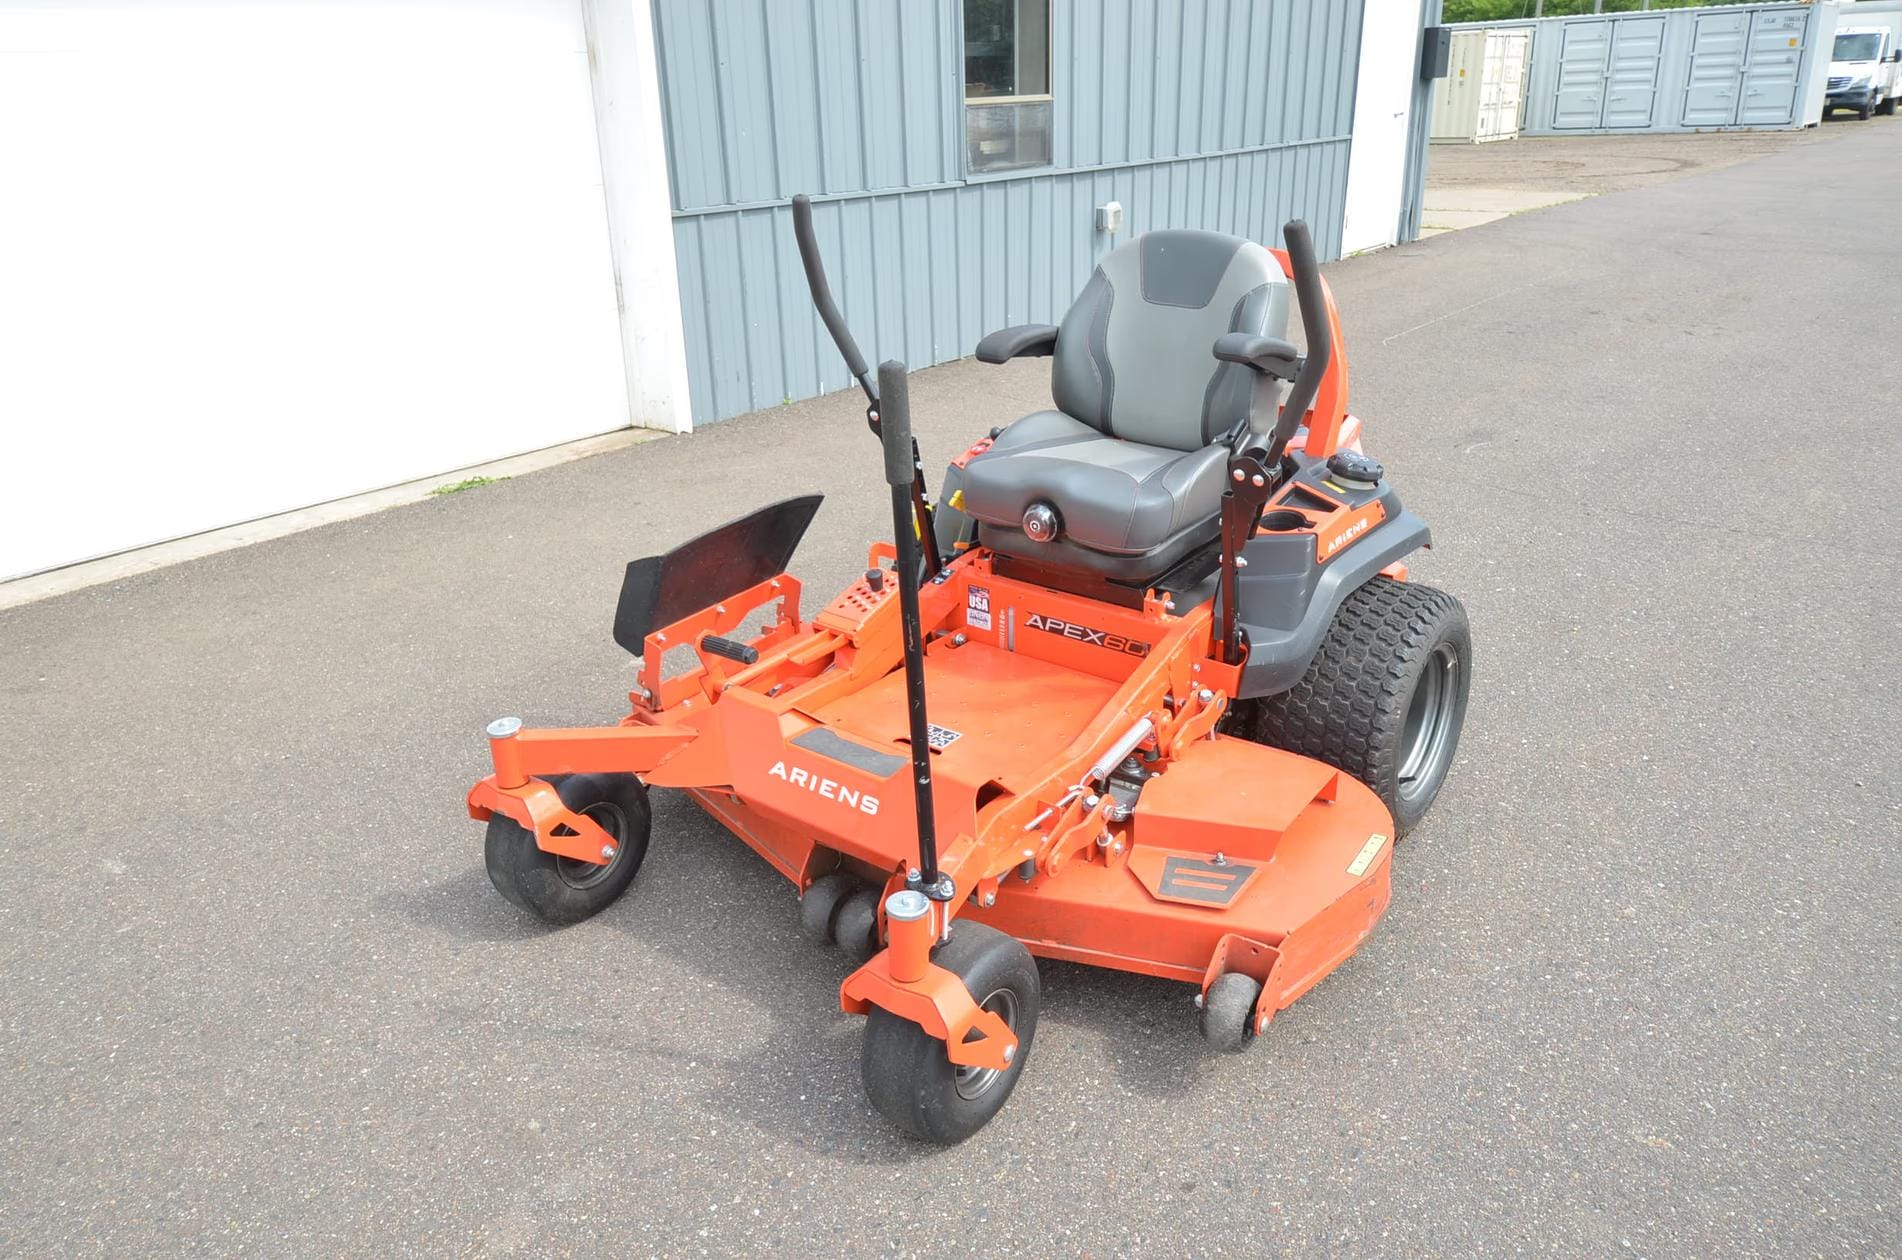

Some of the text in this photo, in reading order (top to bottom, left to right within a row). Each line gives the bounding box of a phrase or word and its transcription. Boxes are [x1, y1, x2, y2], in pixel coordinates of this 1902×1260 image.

[1327, 517, 1369, 554] ARIENS
[969, 594, 989, 612] USA
[768, 760, 880, 816] ARIENS
